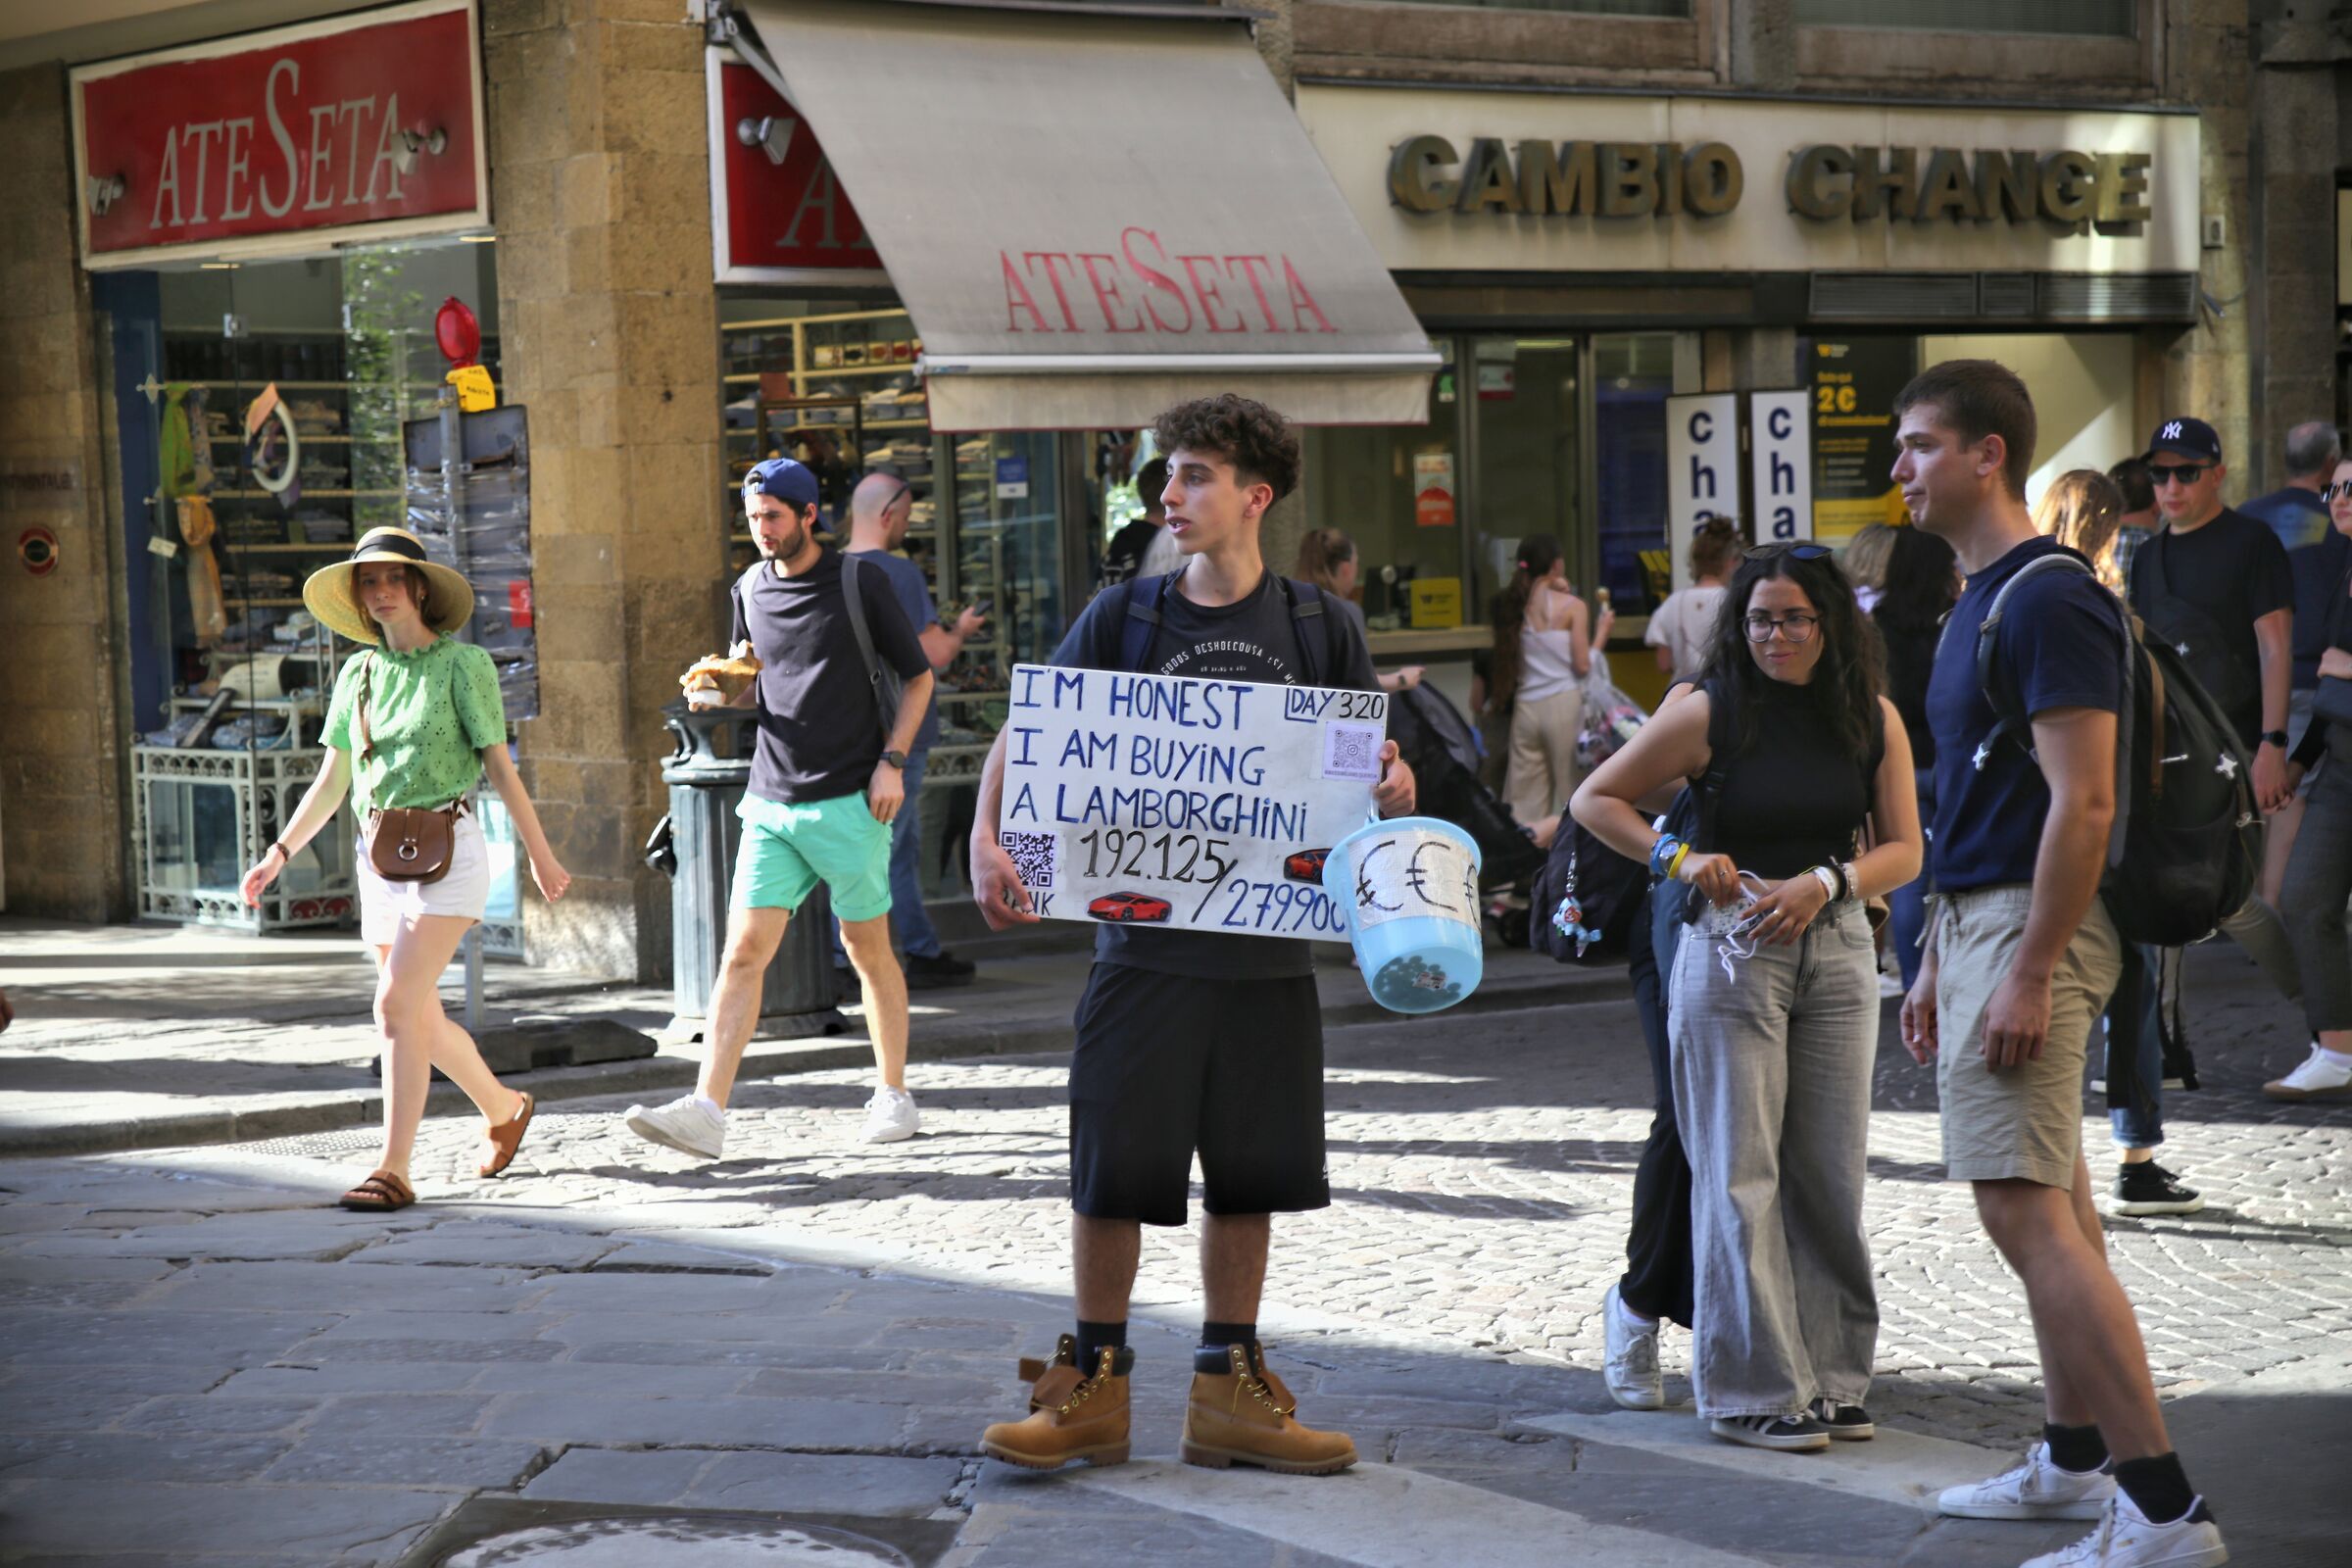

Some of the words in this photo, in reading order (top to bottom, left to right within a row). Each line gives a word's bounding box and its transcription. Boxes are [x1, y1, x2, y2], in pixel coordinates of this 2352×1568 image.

[774, 155, 875, 249] A
[1387, 134, 1744, 220] CAMBIO
[1785, 144, 2151, 225] CHANGE
[1013, 668, 1085, 710] I'M
[1109, 676, 1253, 730] HONEST
[1291, 689, 1336, 717] DAY
[1339, 692, 1384, 719] 320
[1011, 727, 1044, 765] I
[1058, 728, 1117, 771] AM
[1009, 782, 1038, 822] A
